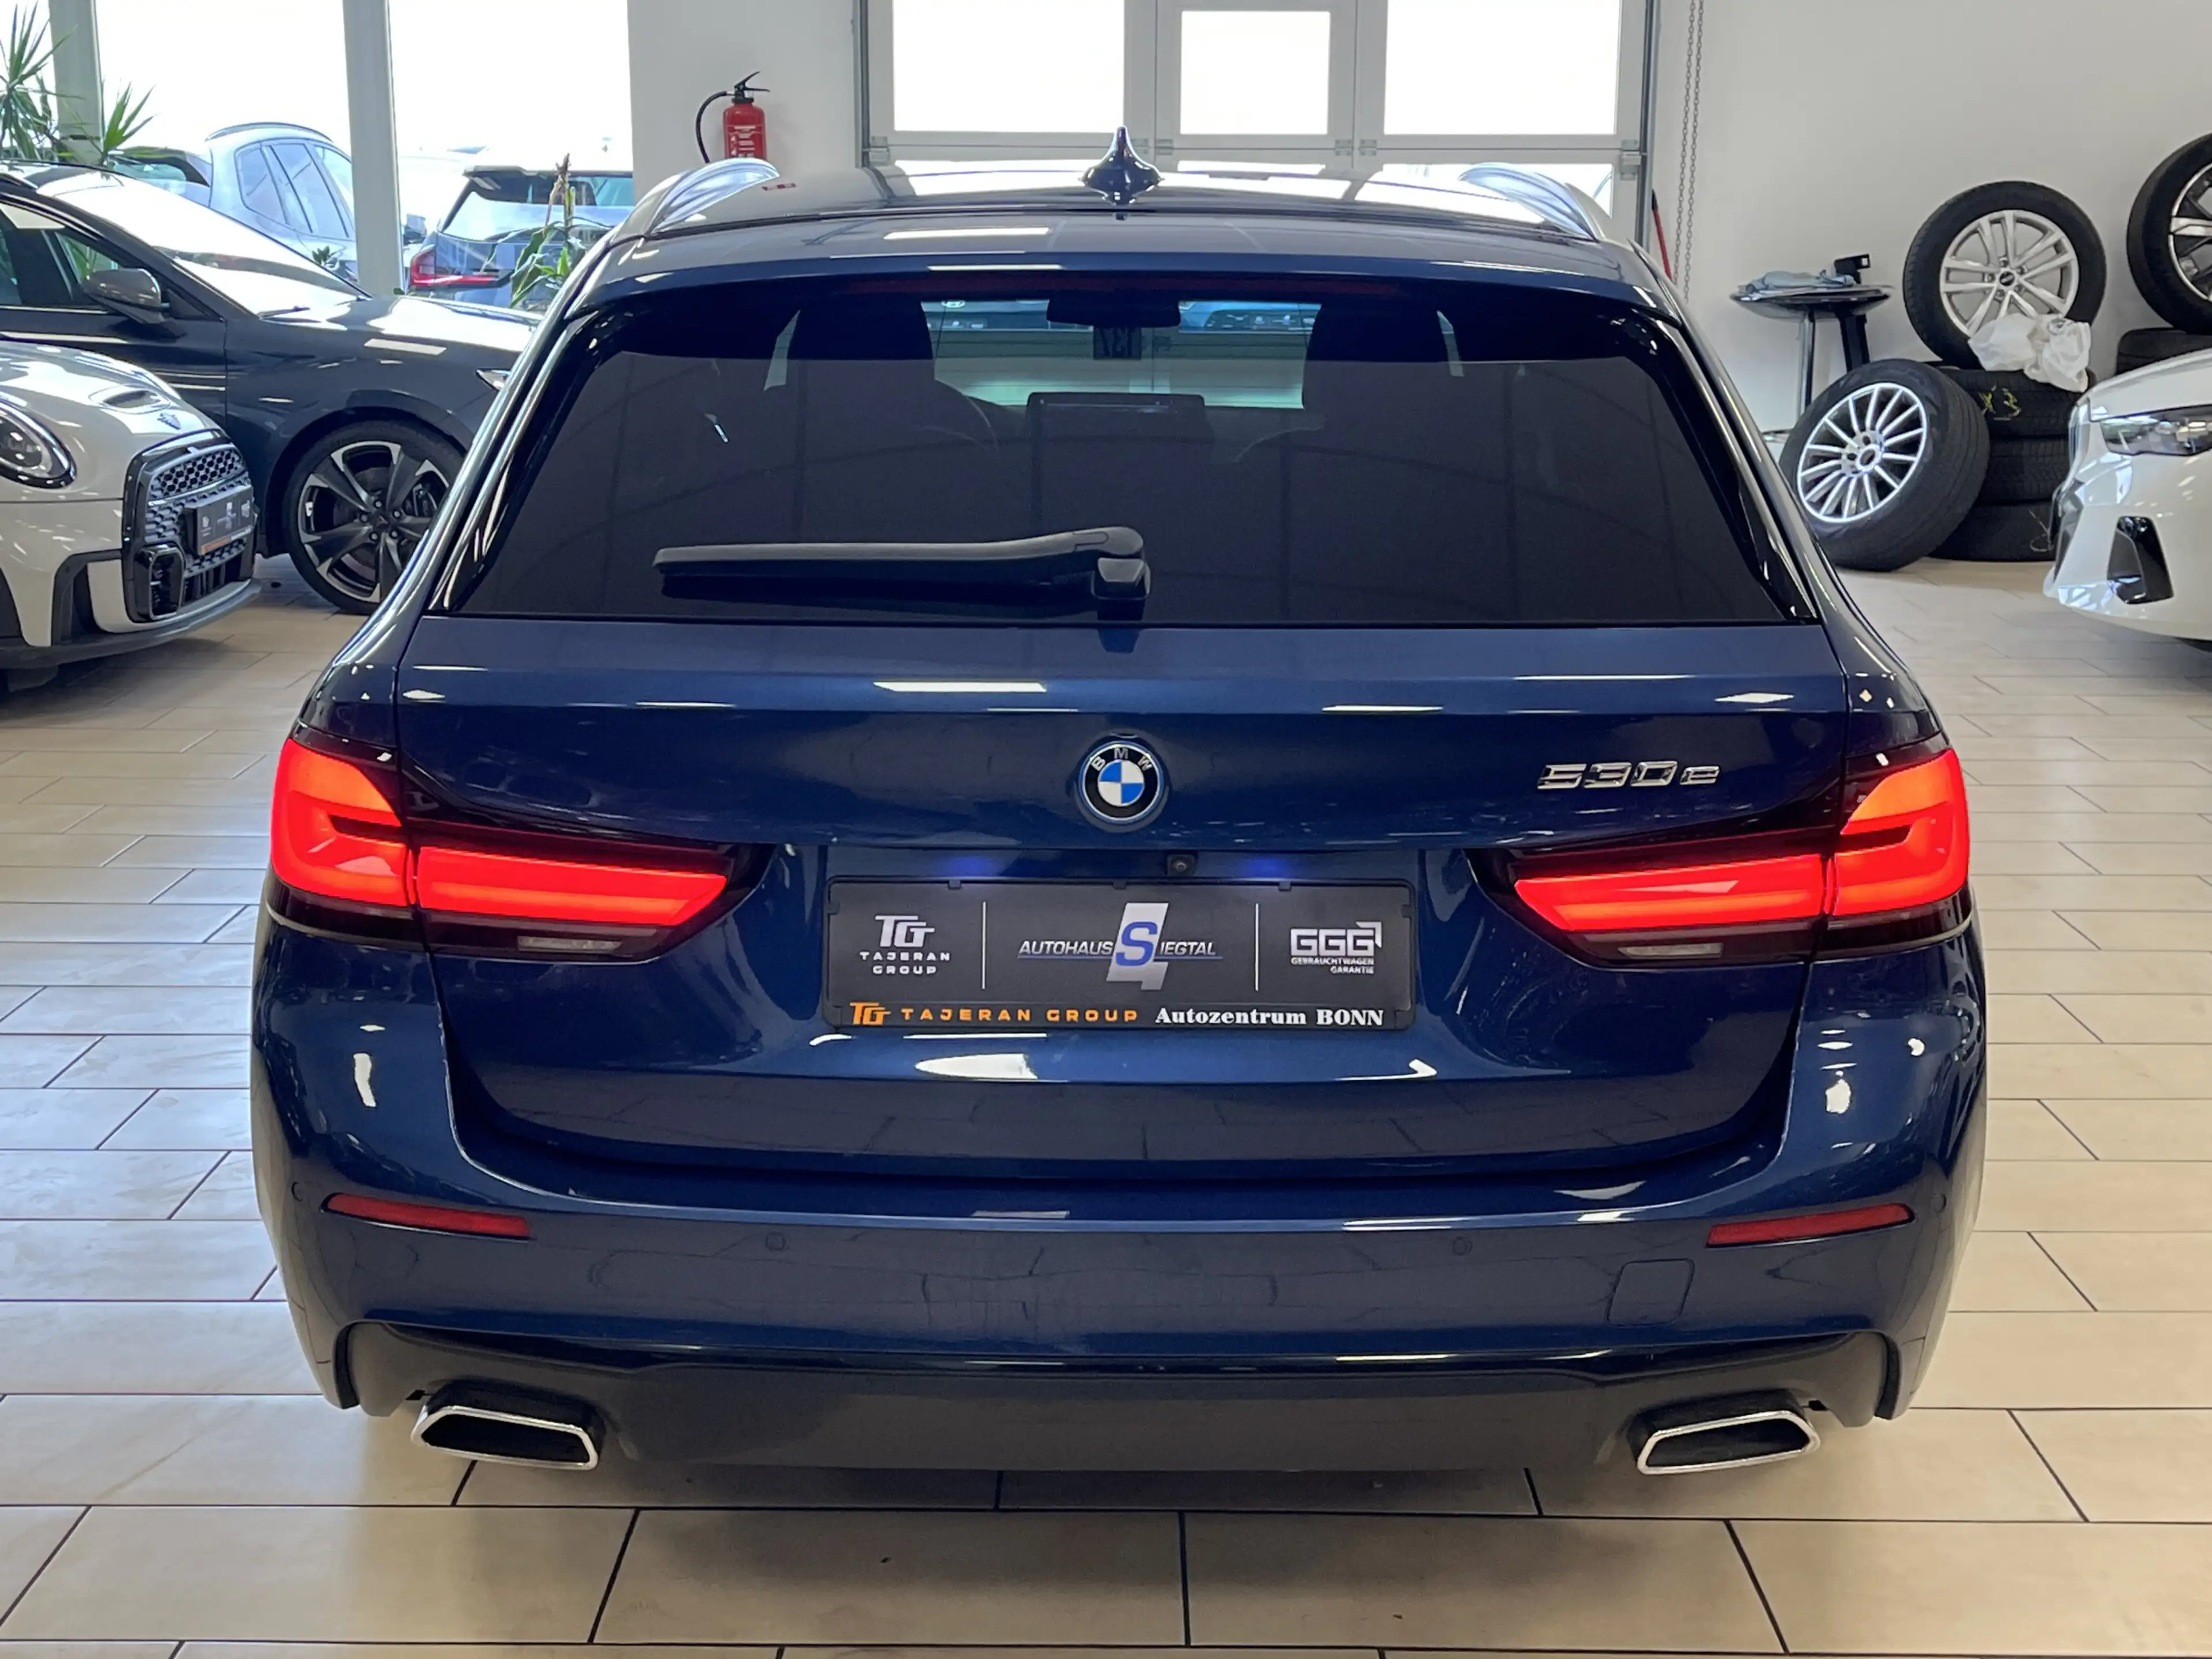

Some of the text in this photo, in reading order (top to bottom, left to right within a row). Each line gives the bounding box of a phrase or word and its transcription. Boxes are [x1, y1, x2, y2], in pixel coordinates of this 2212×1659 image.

[1091, 748, 1152, 771] BMW
[1018, 940, 1113, 955] AUTOHAUS
[1291, 929, 1374, 956] GGG
[859, 952, 950, 961] TAJERAN
[873, 965, 937, 974] GROUP
[902, 1008, 1032, 1021] TAJERAN
[1046, 1009, 1138, 1022] GROUP
[1155, 1007, 1306, 1025] Autozentrum
[1316, 1009, 1383, 1025] BONN
